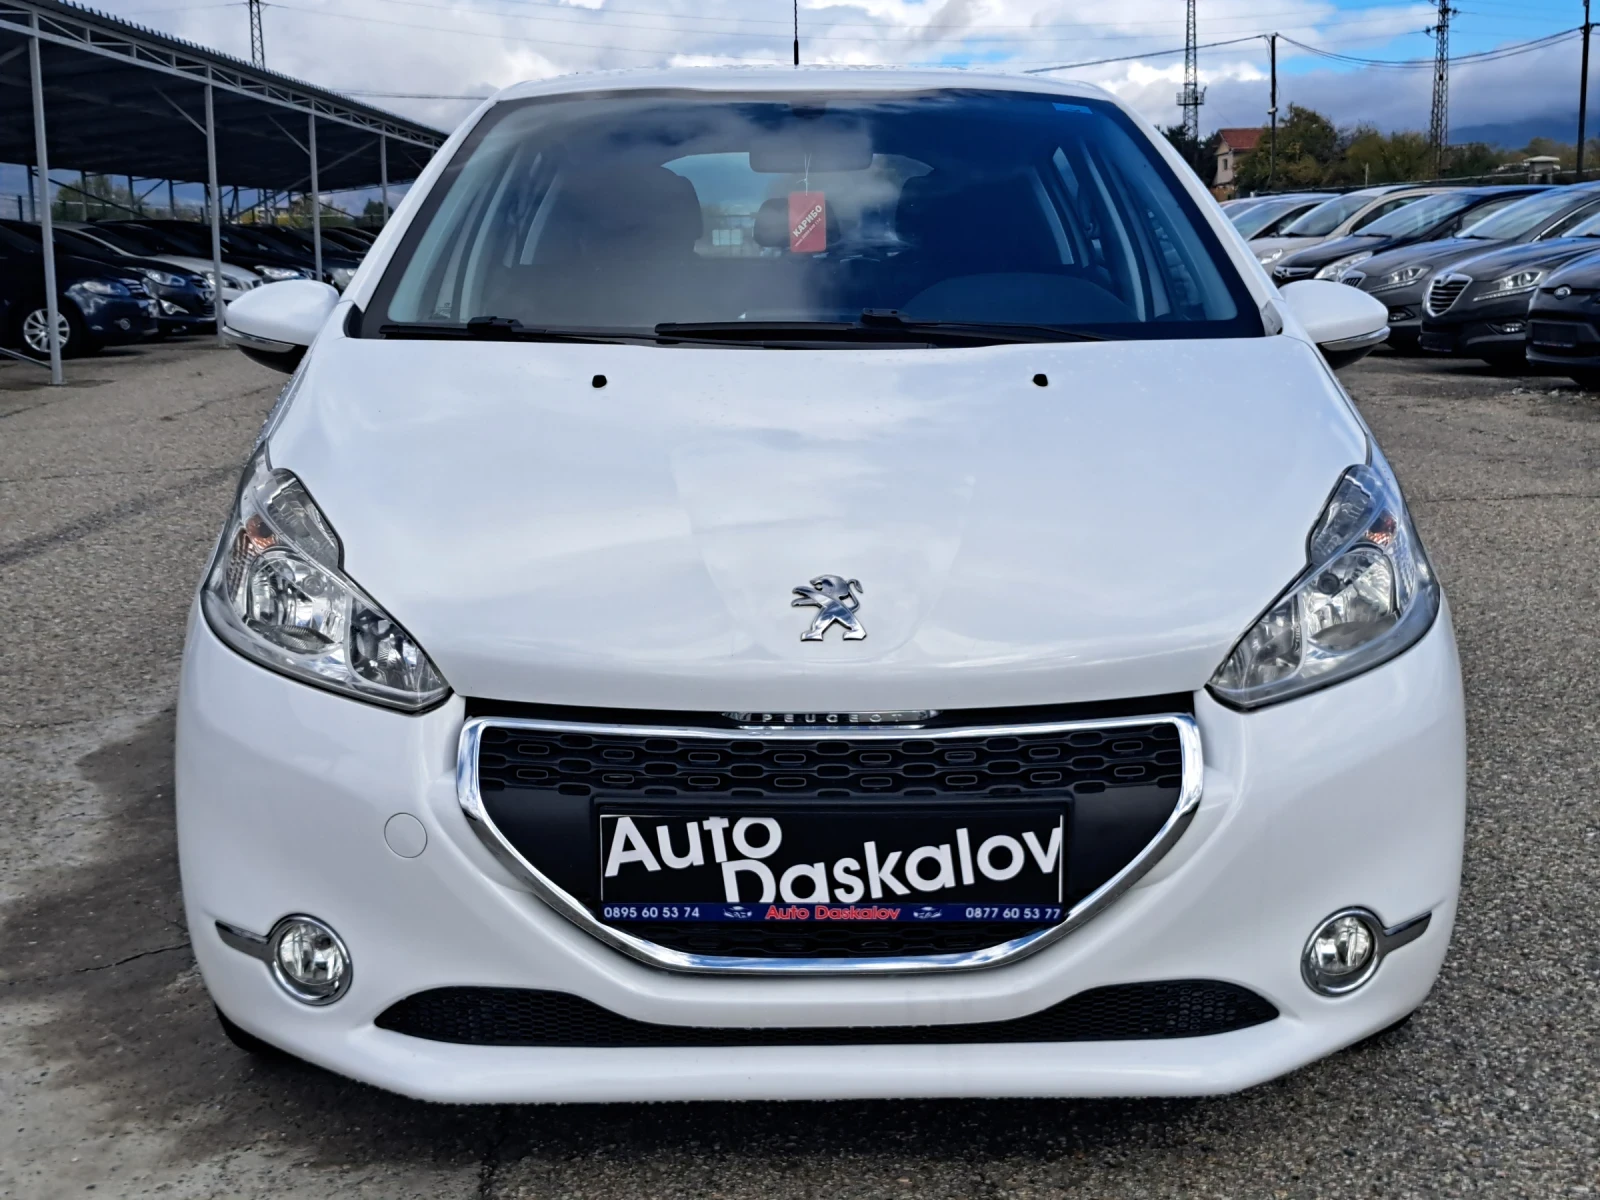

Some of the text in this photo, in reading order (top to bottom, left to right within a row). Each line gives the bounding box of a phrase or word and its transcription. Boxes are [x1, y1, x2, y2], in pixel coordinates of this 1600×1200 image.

[793, 205, 822, 237] КАРИБО
[762, 713, 902, 722] PEUGEOT
[604, 816, 782, 878] Auto
[721, 827, 1060, 903] Daskalov
[604, 907, 699, 918] 0895 60 53 74
[765, 905, 900, 920] Auto Daskalov
[965, 907, 1061, 919] 0877 60 53 77
